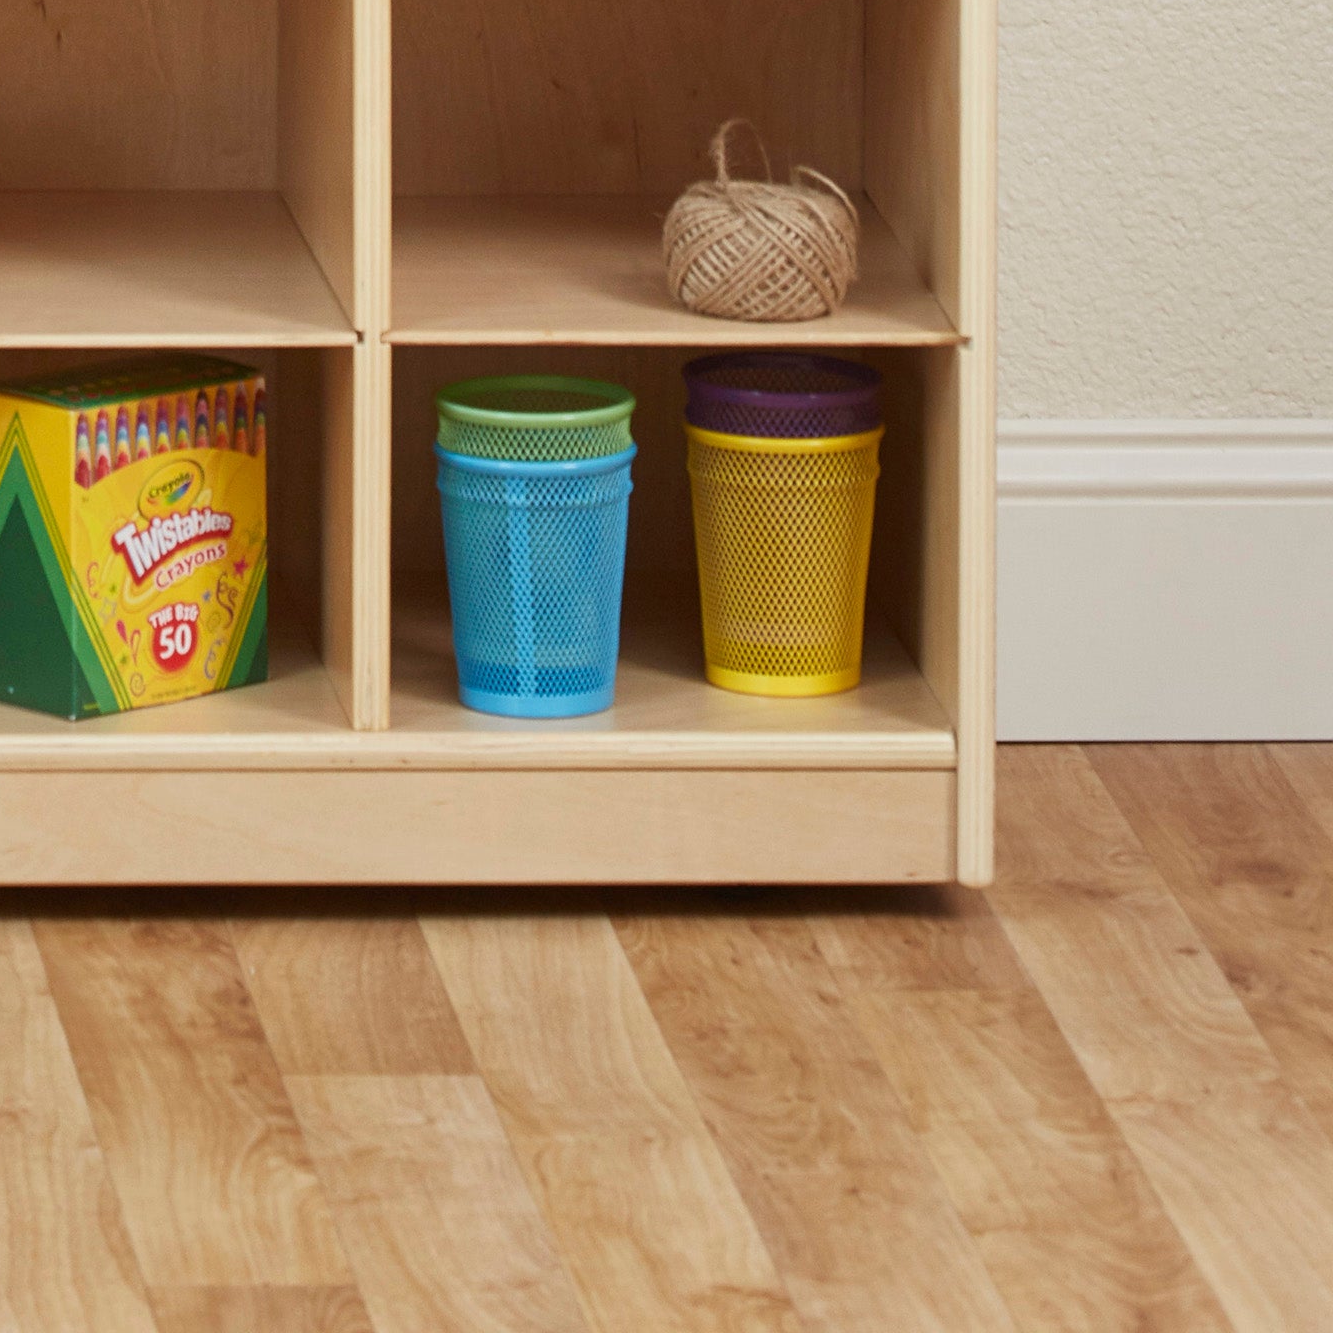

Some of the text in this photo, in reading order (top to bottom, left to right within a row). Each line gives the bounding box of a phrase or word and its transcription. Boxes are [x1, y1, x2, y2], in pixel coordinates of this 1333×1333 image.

[114, 508, 231, 578] Twistables
[155, 543, 226, 589] Crayons
[148, 604, 173, 628] THE
[159, 623, 192, 660] 50
